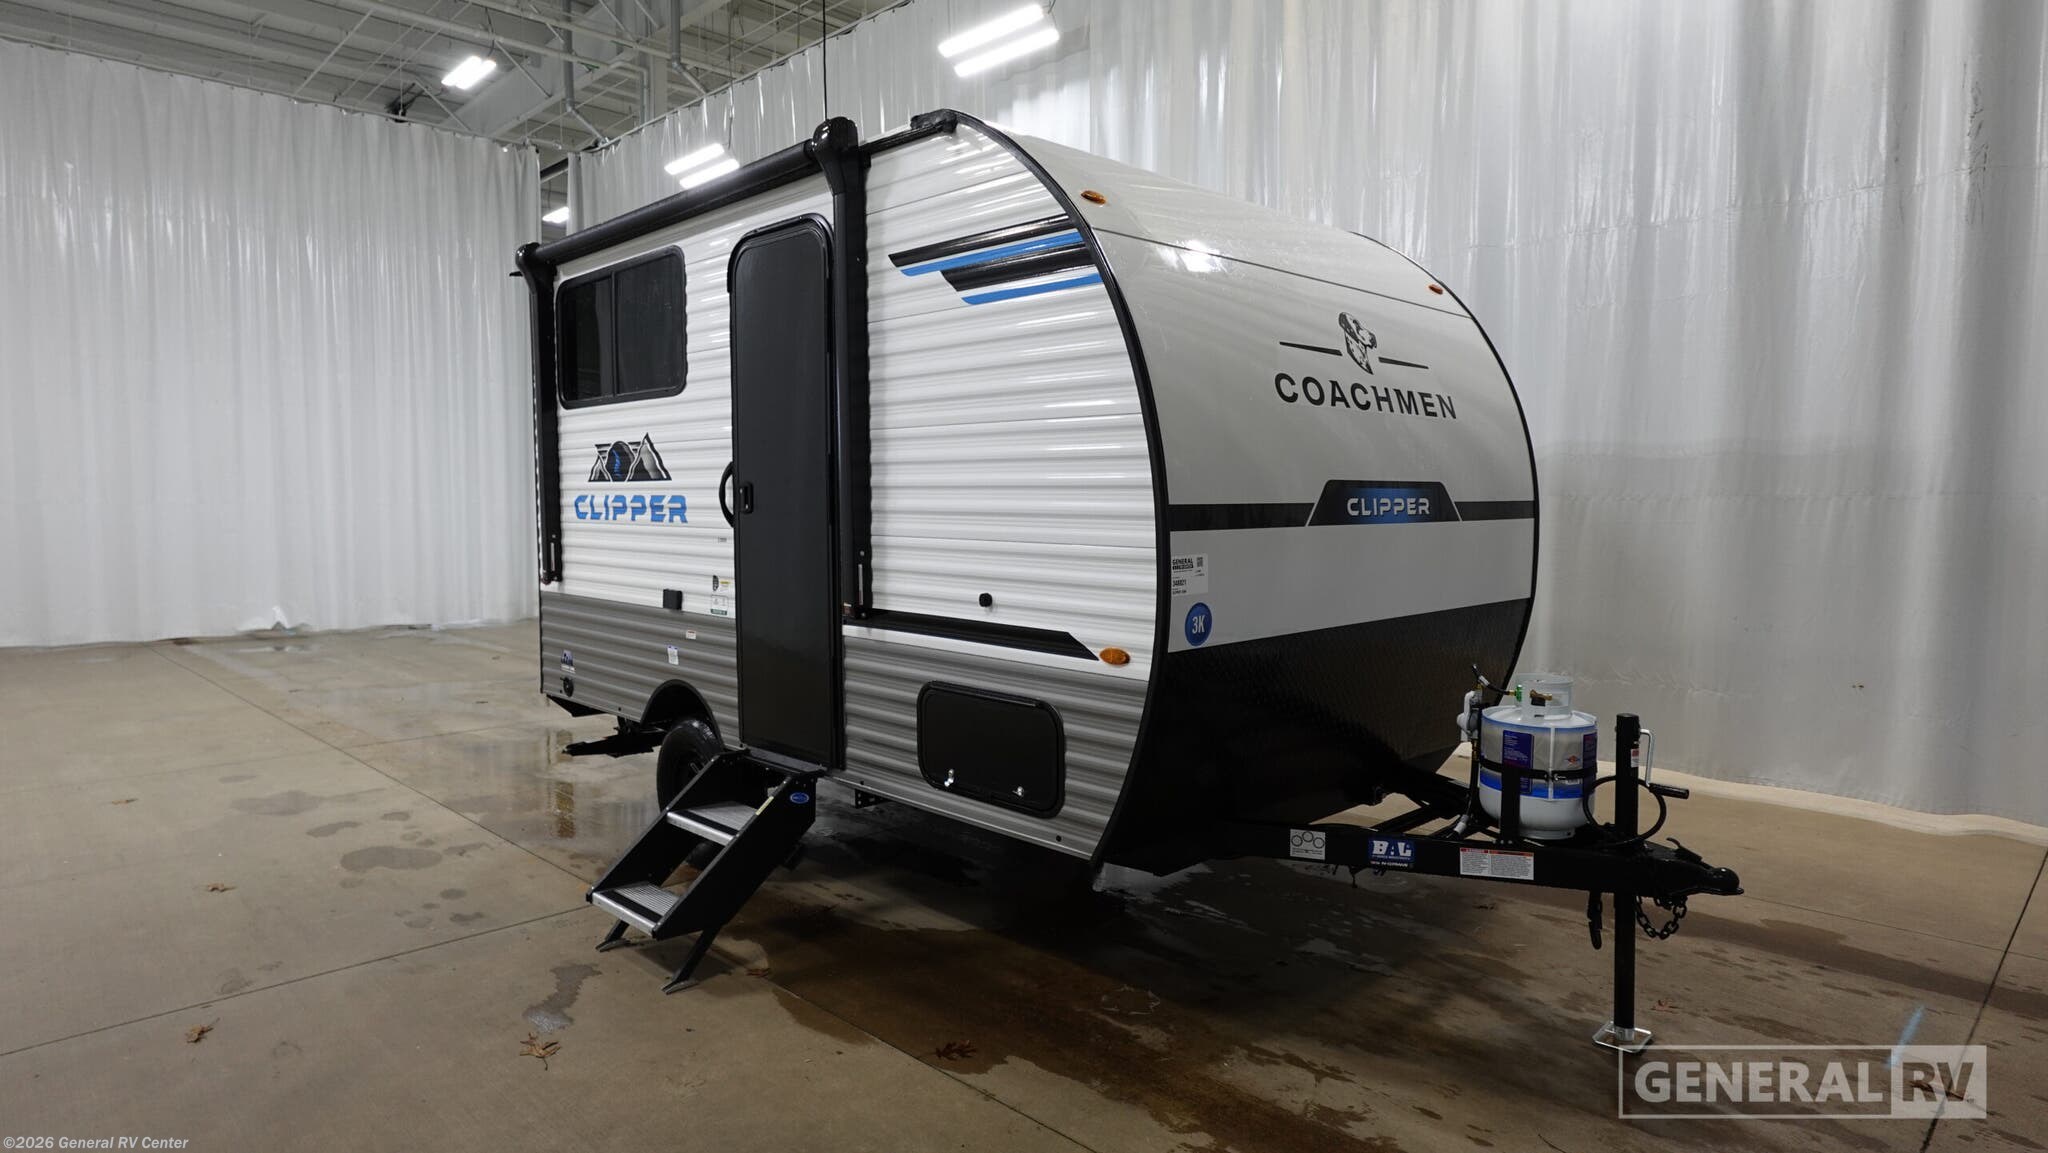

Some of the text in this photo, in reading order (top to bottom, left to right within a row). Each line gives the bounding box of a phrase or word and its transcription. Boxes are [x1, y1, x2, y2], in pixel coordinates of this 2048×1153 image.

[1274, 372, 1457, 419] COACHMEN
[574, 494, 688, 523] CLIPPER
[1347, 497, 1430, 516] CLIPPER
[1192, 615, 1205, 634] 3K
